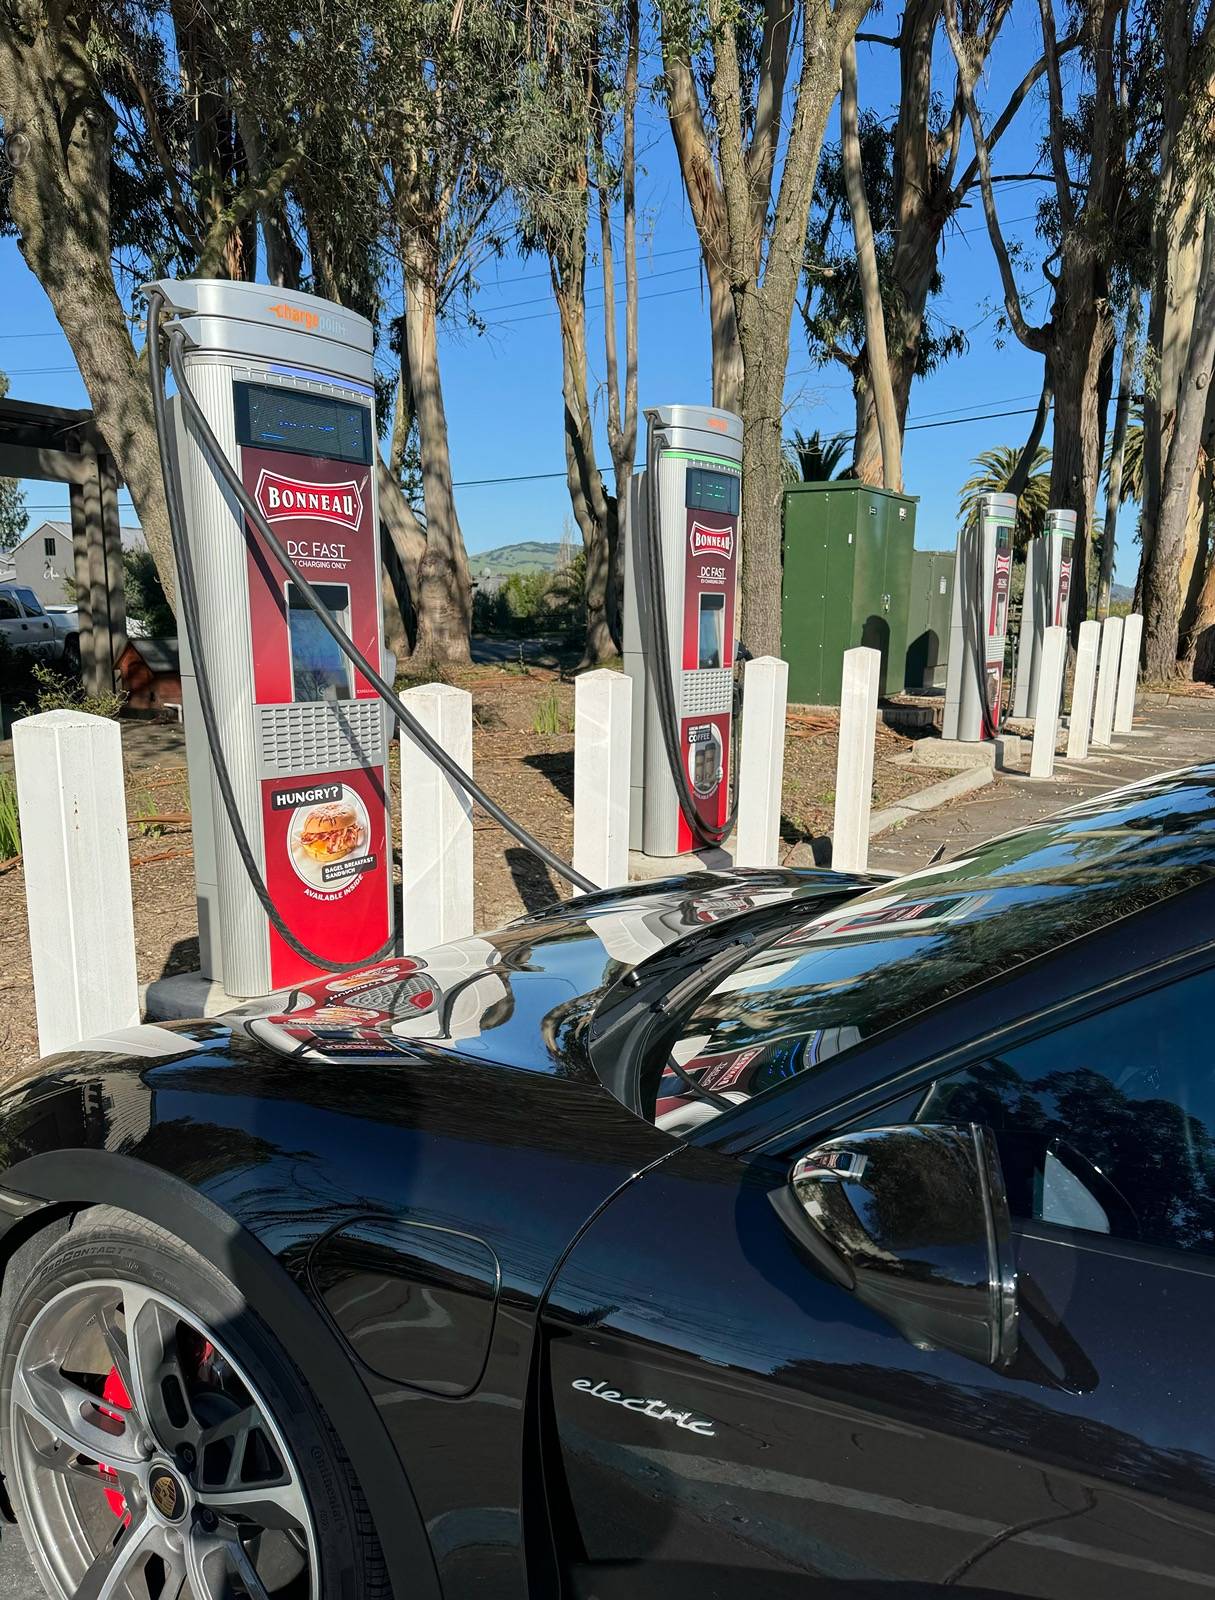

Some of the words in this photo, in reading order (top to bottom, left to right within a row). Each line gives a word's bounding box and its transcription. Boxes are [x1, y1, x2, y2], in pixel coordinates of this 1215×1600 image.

[268, 486, 353, 516] BONNEAU
[287, 541, 308, 556] DC
[312, 543, 346, 558] FAST
[695, 532, 730, 550] BONNEAU
[298, 560, 330, 569] CHARGING
[331, 562, 347, 570] ONLY
[700, 566, 710, 577] DC
[711, 567, 725, 578] FAST
[276, 786, 339, 806] HUNGRY?
[324, 864, 343, 874] BAGEL
[344, 856, 374, 869] BREAKFAST
[325, 867, 356, 880] SANDWICH
[304, 888, 343, 901] AVAILABLE
[343, 873, 364, 896] INSIDE
[571, 1378, 715, 1437] electric
